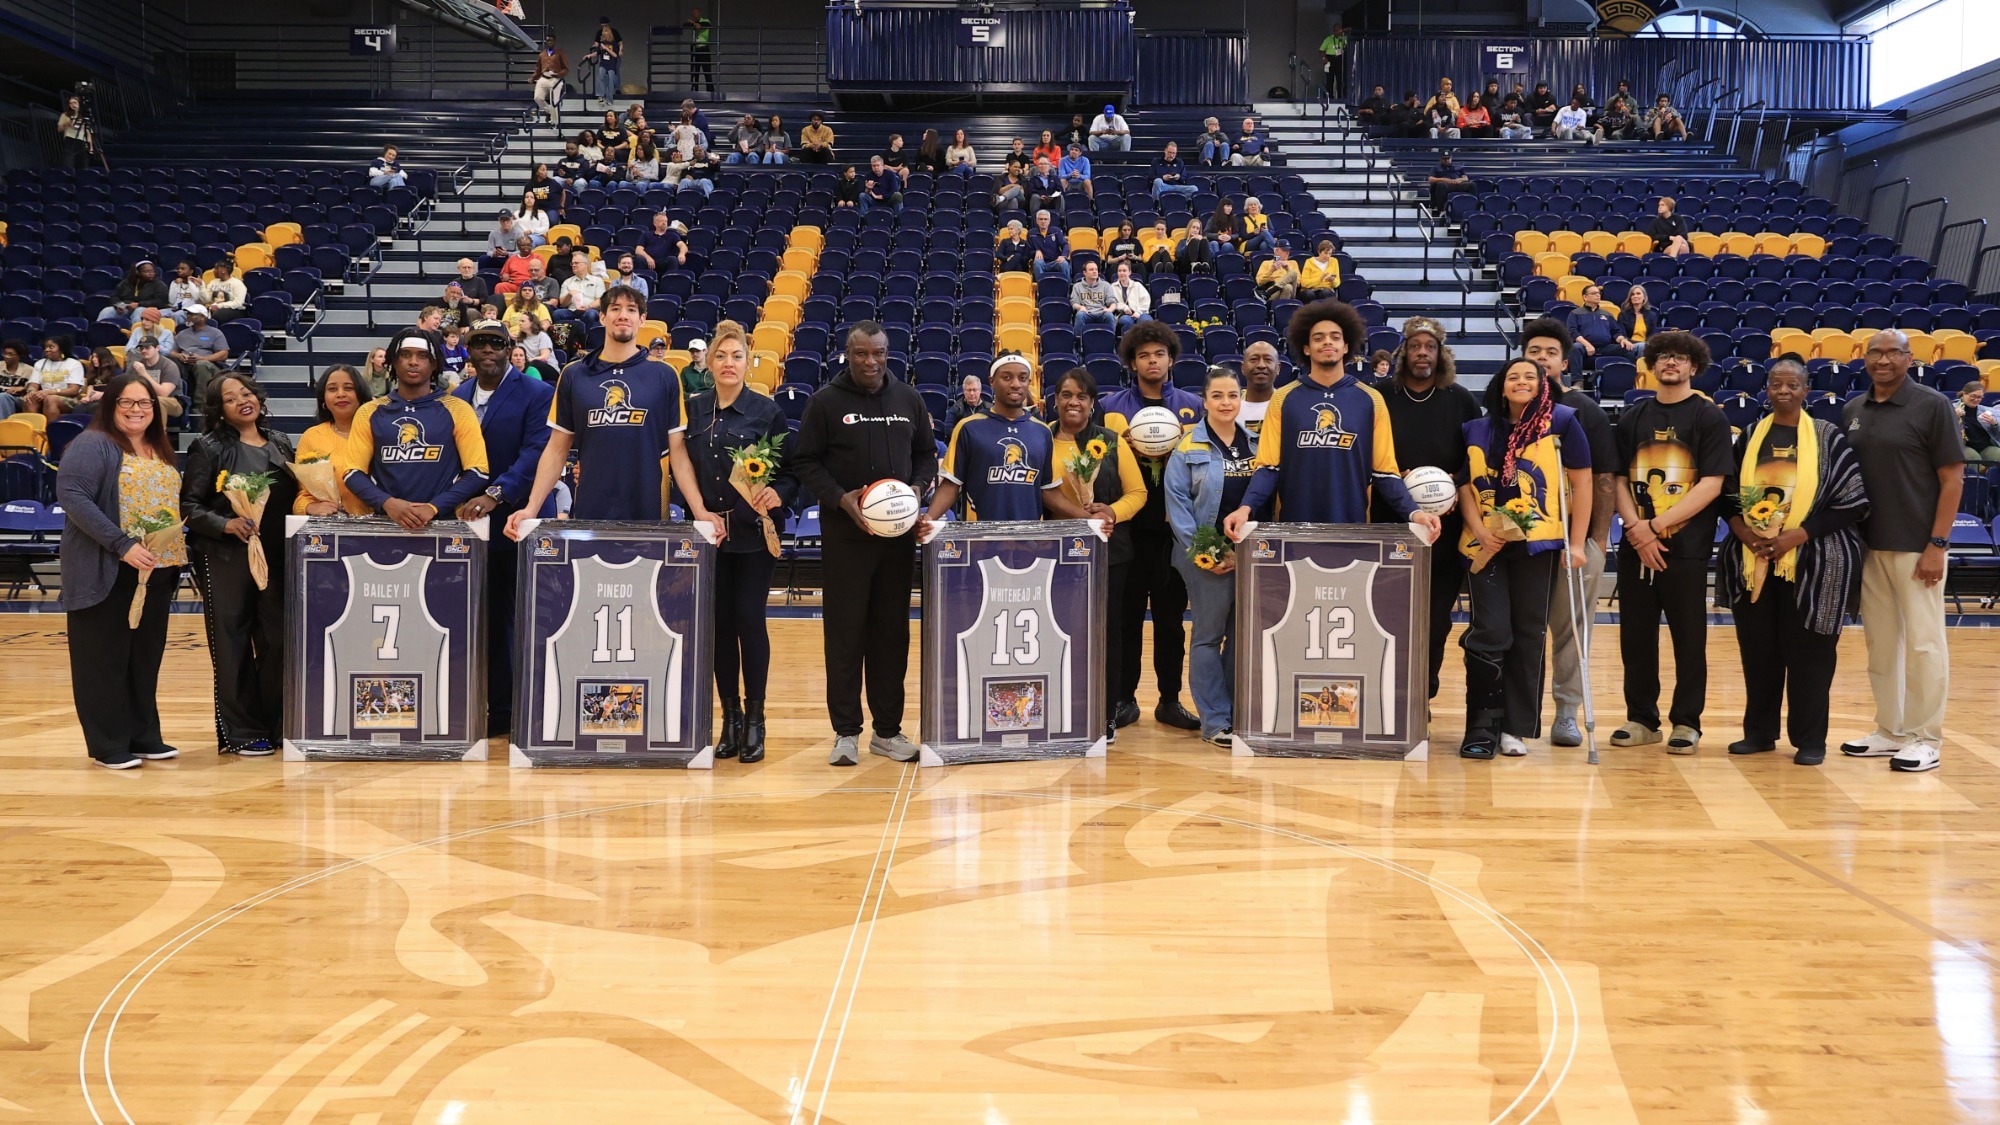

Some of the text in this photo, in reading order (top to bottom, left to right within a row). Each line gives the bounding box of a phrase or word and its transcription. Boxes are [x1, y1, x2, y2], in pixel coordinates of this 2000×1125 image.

[972, 26, 989, 41] 5
[365, 36, 381, 51] 4
[1497, 54, 1513, 68] 6
[1080, 292, 1103, 300] UNCG
[588, 411, 645, 425] UNCG
[843, 413, 910, 426] Champion
[1149, 426, 1160, 434] 500
[1299, 431, 1354, 448] UNCG
[382, 447, 441, 461] UNCG
[989, 468, 1037, 483] UNCG
[363, 583, 410, 598] BAILEY II
[597, 583, 633, 599] PINEDO
[990, 587, 1031, 602] WHITEHEAD
[1315, 586, 1347, 600] NEELY
[372, 604, 401, 660] 7
[592, 605, 636, 662] 11
[991, 608, 1041, 665] 13
[1305, 606, 1355, 660] 12
